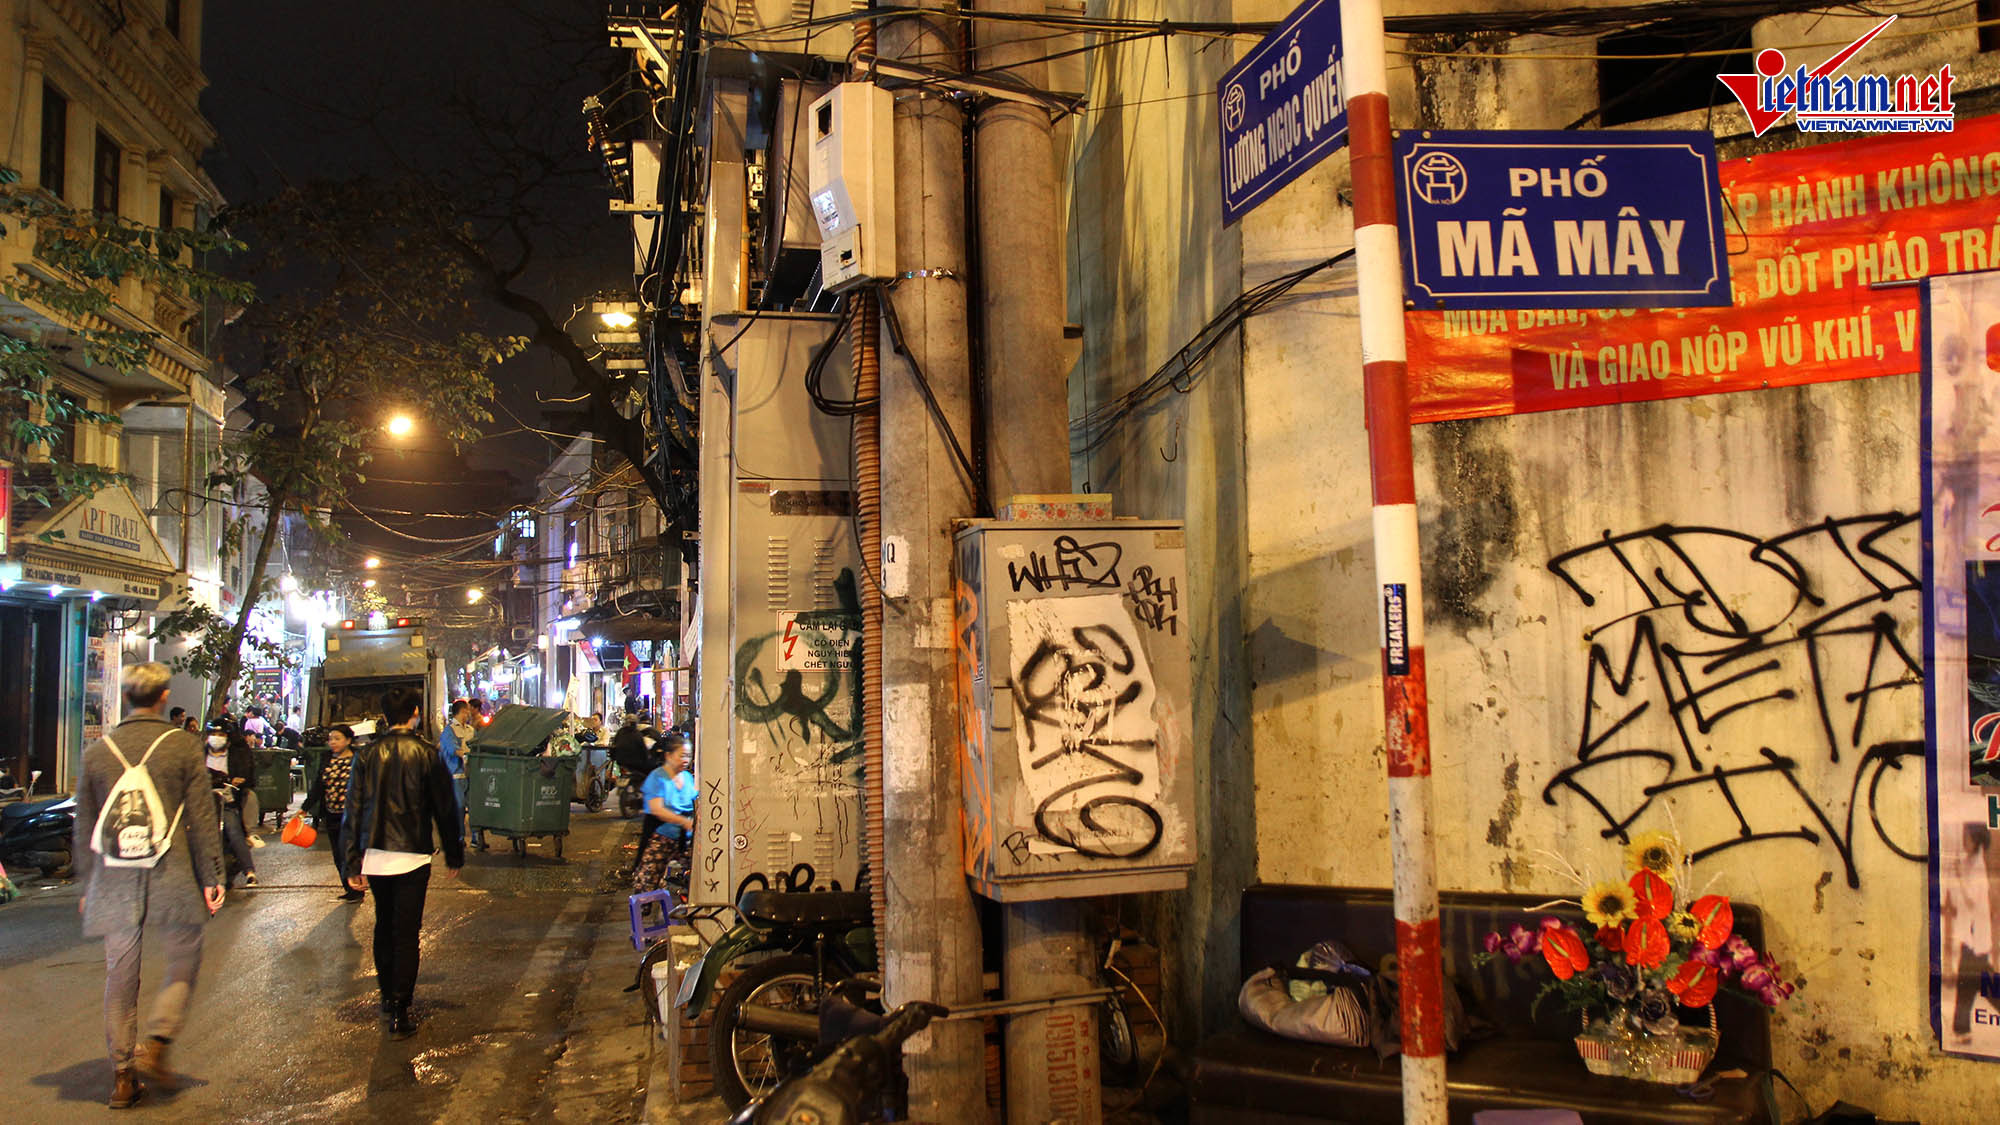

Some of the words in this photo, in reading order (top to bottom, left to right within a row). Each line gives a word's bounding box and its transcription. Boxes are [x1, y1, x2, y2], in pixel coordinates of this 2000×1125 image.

[1259, 29, 1302, 100] PHỐ
[1229, 122, 1267, 195] LƯƠNG
[1267, 94, 1301, 163] NGỌC
[1509, 154, 1608, 197] PHỐ
[1770, 175, 1867, 228] HÀNH
[1877, 152, 2000, 213] KHÔNG
[1436, 206, 1540, 277] MÃ
[1553, 206, 1685, 276] MÂY
[1755, 239, 1821, 300] ĐỐT
[1831, 231, 1930, 290] PHÁO
[1549, 341, 1589, 391] VÀ
[1597, 339, 1672, 387] GIAO
[1681, 324, 1748, 383] NỘP
[1758, 315, 1803, 368] VŨ
[1813, 306, 1885, 363] KHÍ,
[80, 508, 107, 534] APT
[109, 513, 140, 542] TRAVEL
[808, 650, 833, 658] NGUY
